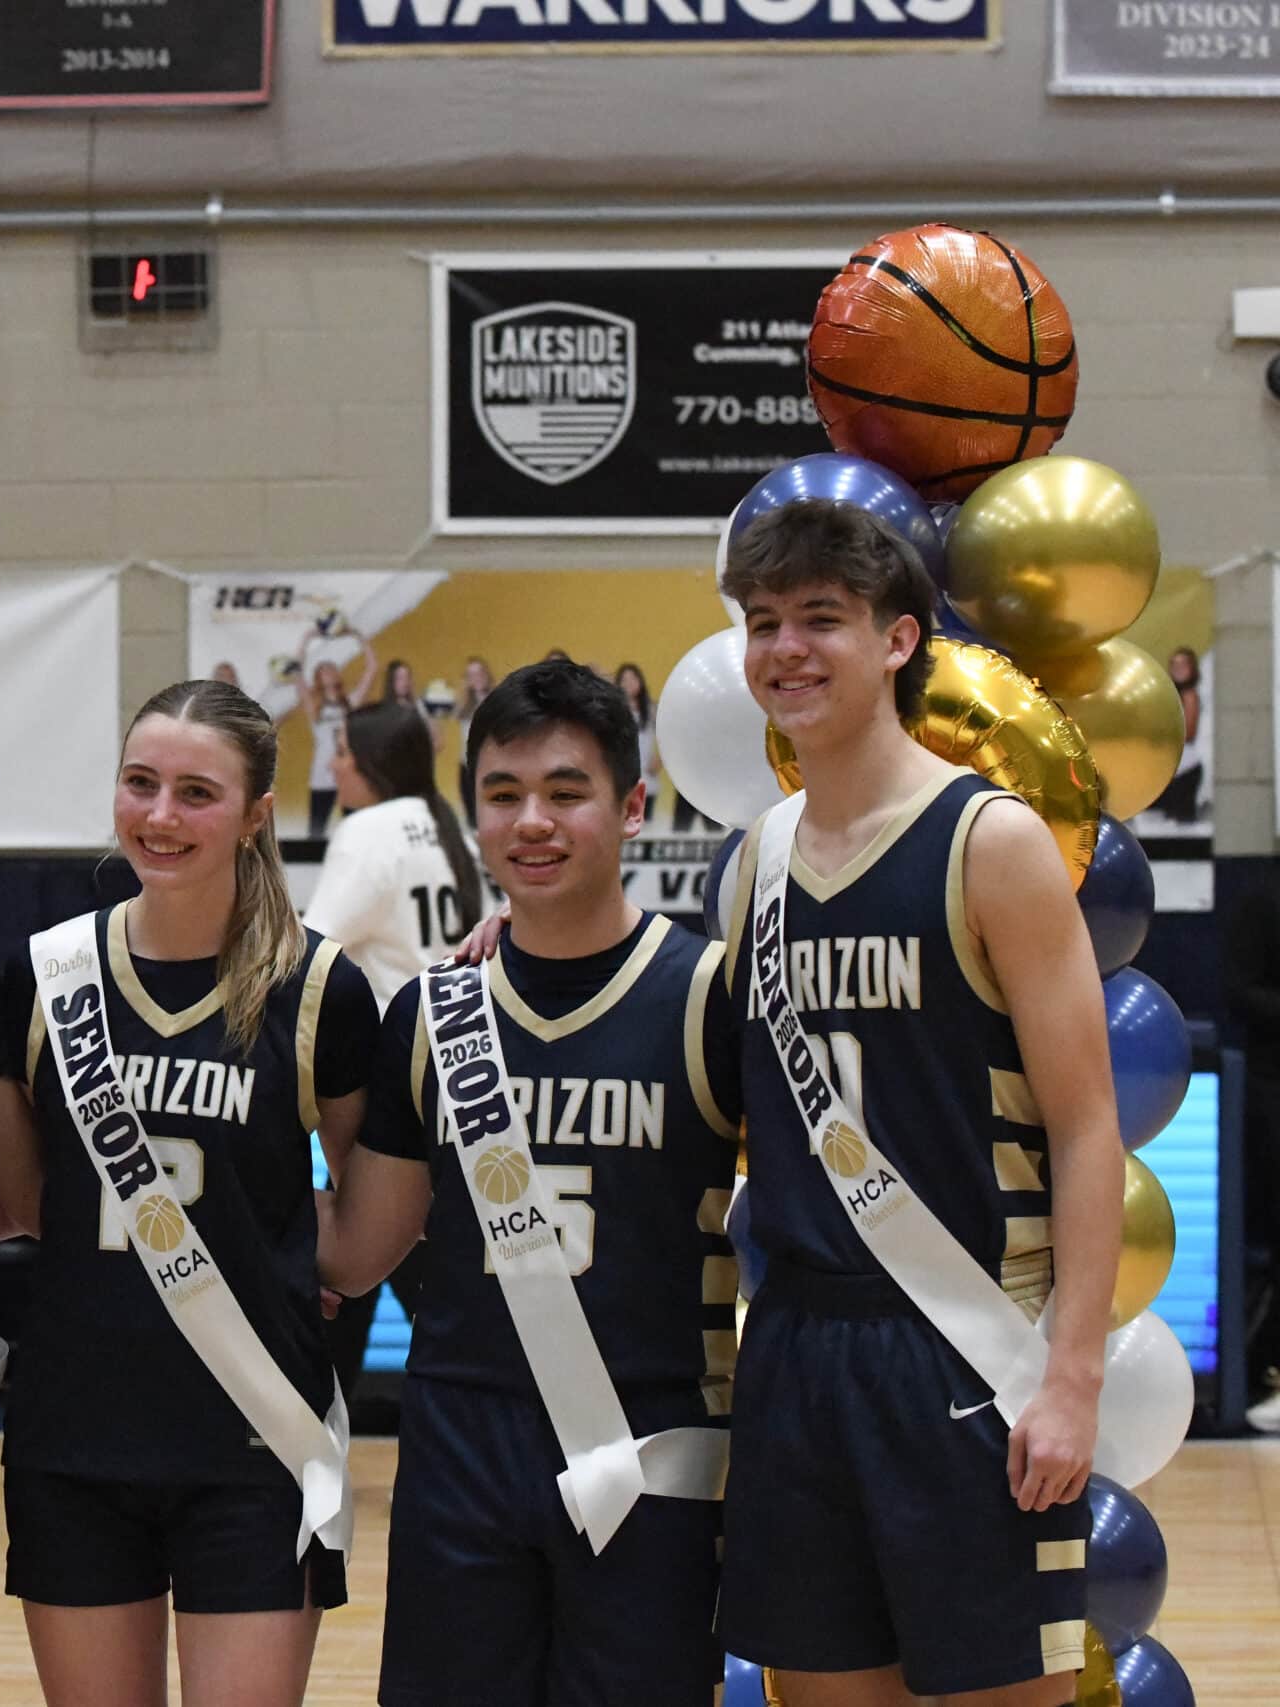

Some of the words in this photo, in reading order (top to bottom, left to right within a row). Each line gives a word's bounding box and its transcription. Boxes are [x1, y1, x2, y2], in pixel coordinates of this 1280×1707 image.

[1118, 3, 1263, 28] DIVISION
[1165, 33, 1270, 60] 2023-24
[484, 325, 625, 362] LAKESIDE
[484, 364, 626, 399] MUNITIONS
[409, 884, 463, 948] 10
[440, 1034, 493, 1069] 2026
[78, 1084, 125, 1126] 2026
[847, 1169, 898, 1215] HCA
[488, 1206, 547, 1241] HCA
[157, 1248, 209, 1288] HCA
